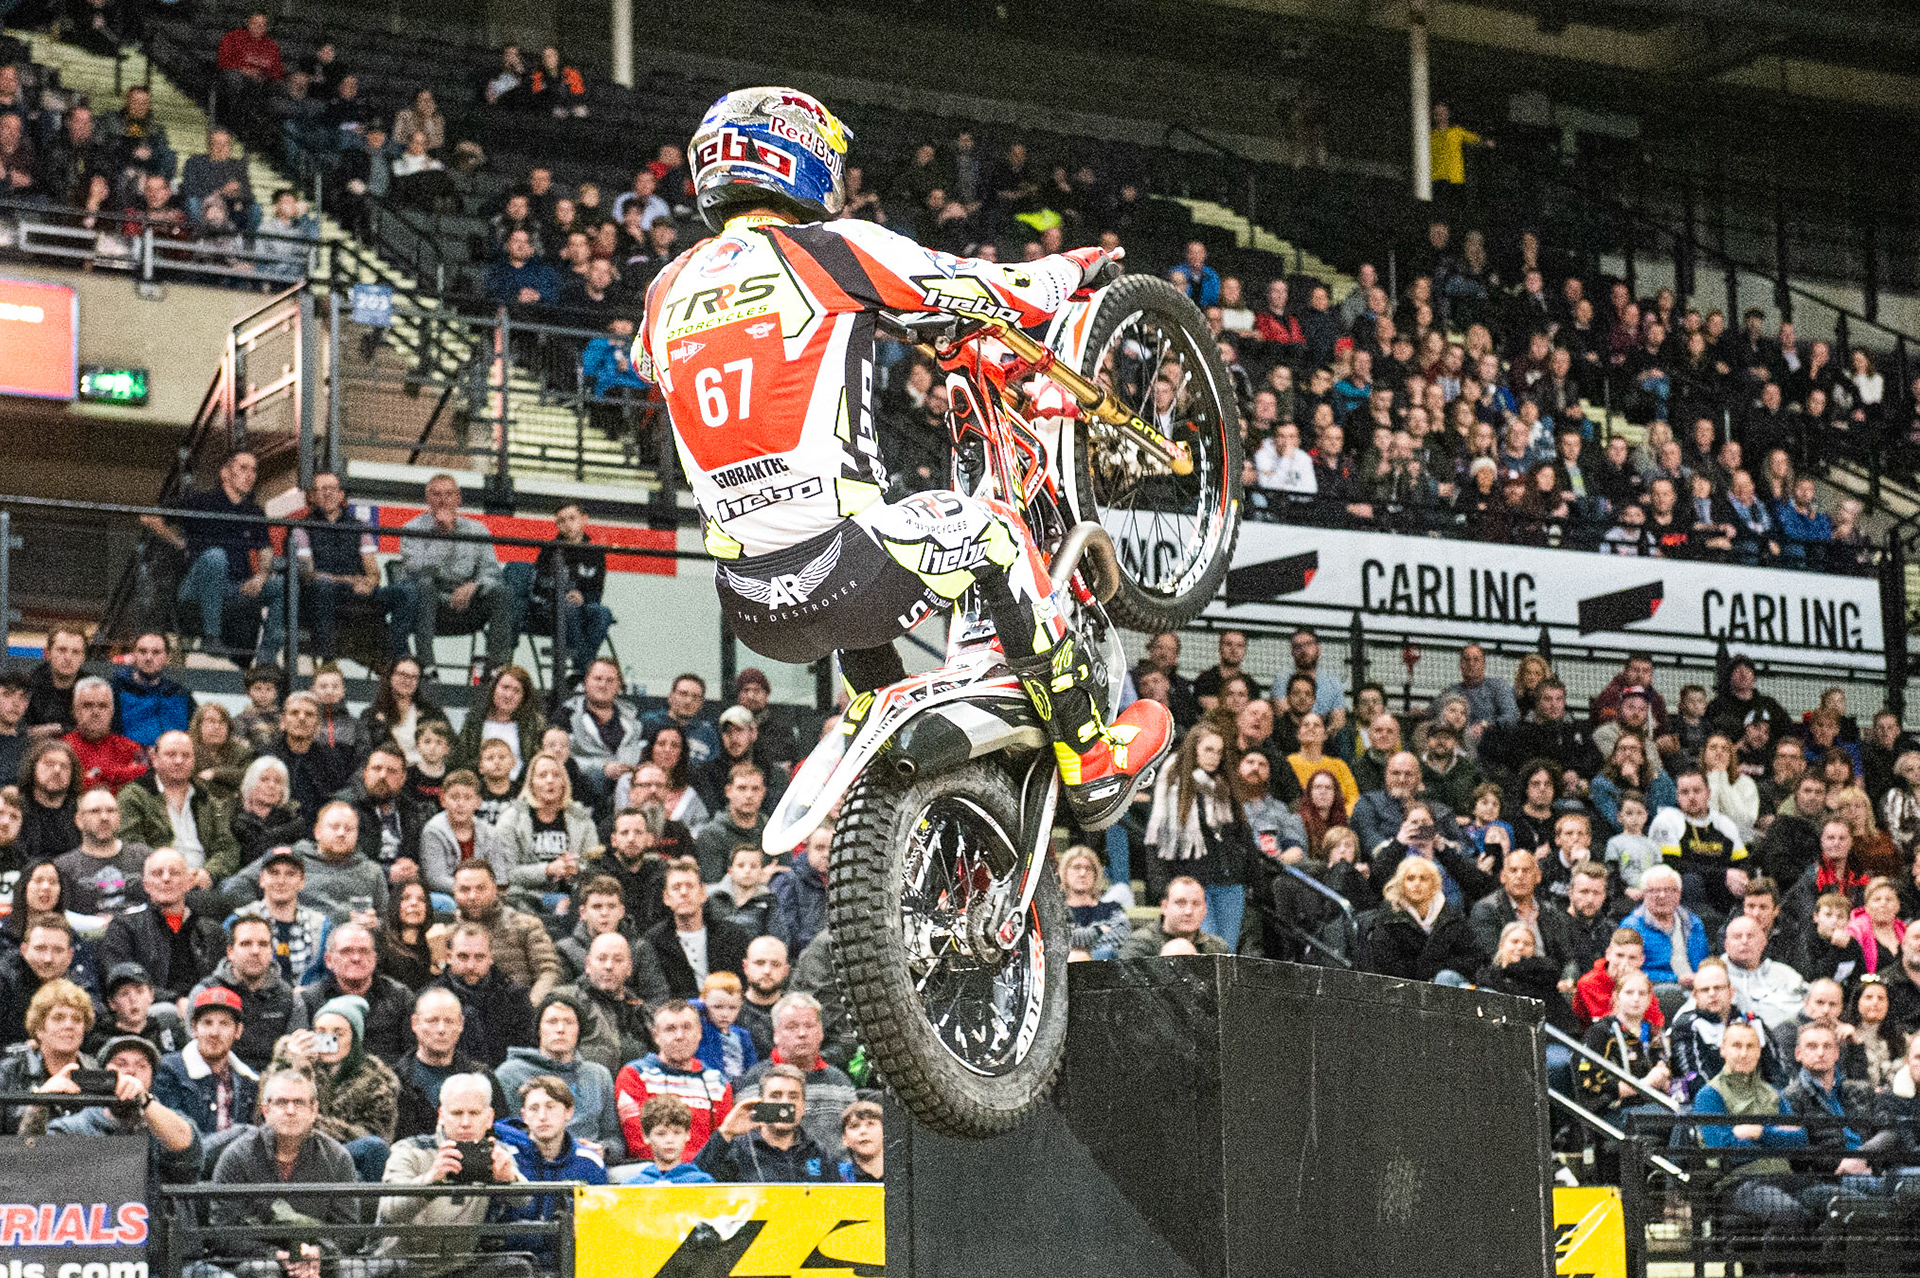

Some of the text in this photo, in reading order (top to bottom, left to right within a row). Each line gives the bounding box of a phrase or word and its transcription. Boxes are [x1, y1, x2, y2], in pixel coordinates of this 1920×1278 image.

[771, 116, 841, 179] Red Bull
[923, 288, 1024, 325] hebo
[695, 357, 754, 428] 67
[725, 457, 790, 487] BRAKTEC
[716, 476, 824, 523] hebo
[918, 535, 991, 575] hebo
[738, 579, 858, 624] THE DESTROYER
[1361, 558, 1537, 622] CARLING
[1702, 588, 1862, 650] CARLING
